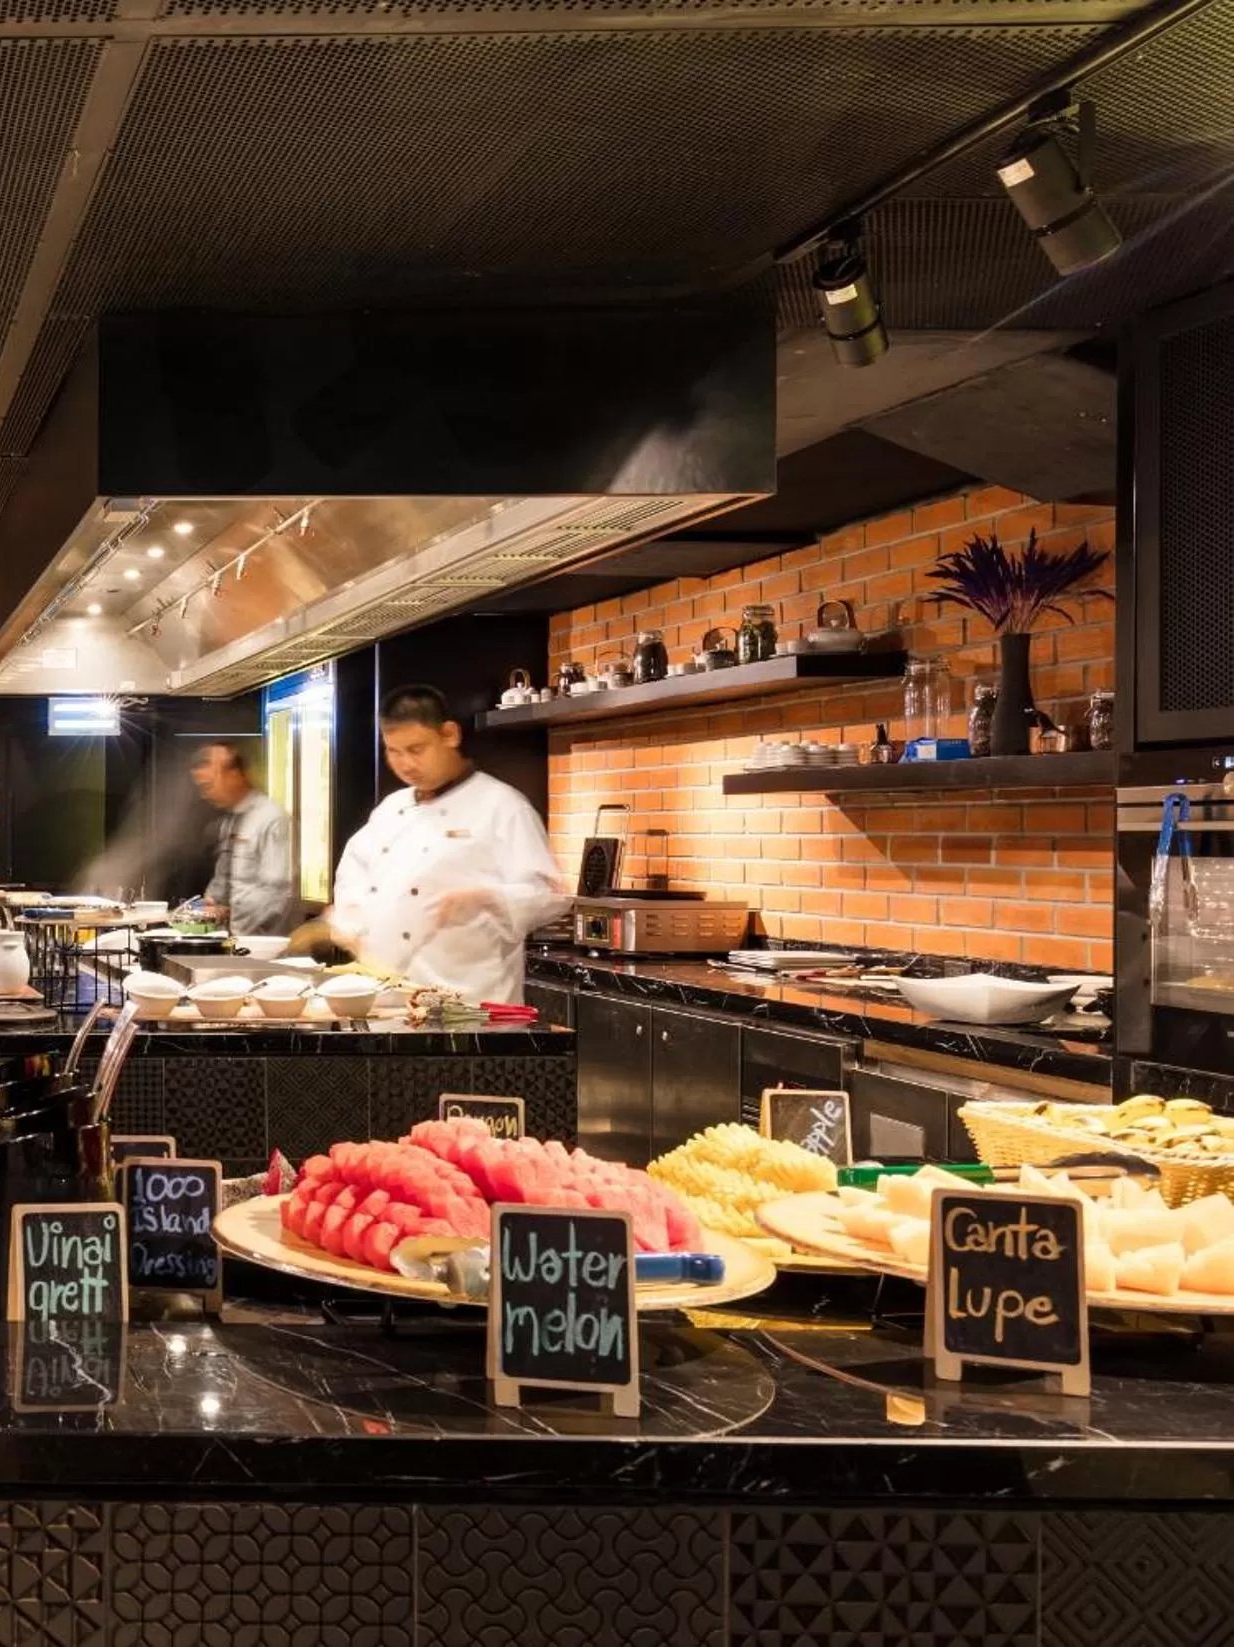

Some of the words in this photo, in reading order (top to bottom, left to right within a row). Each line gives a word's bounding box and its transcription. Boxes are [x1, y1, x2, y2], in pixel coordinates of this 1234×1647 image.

[133, 1167, 205, 1204] 1000
[27, 1215, 116, 1269] Vinai
[133, 1203, 211, 1235] Island
[945, 1206, 1066, 1261] Canta
[503, 1220, 627, 1290] Water
[948, 1266, 1060, 1343] Lupe
